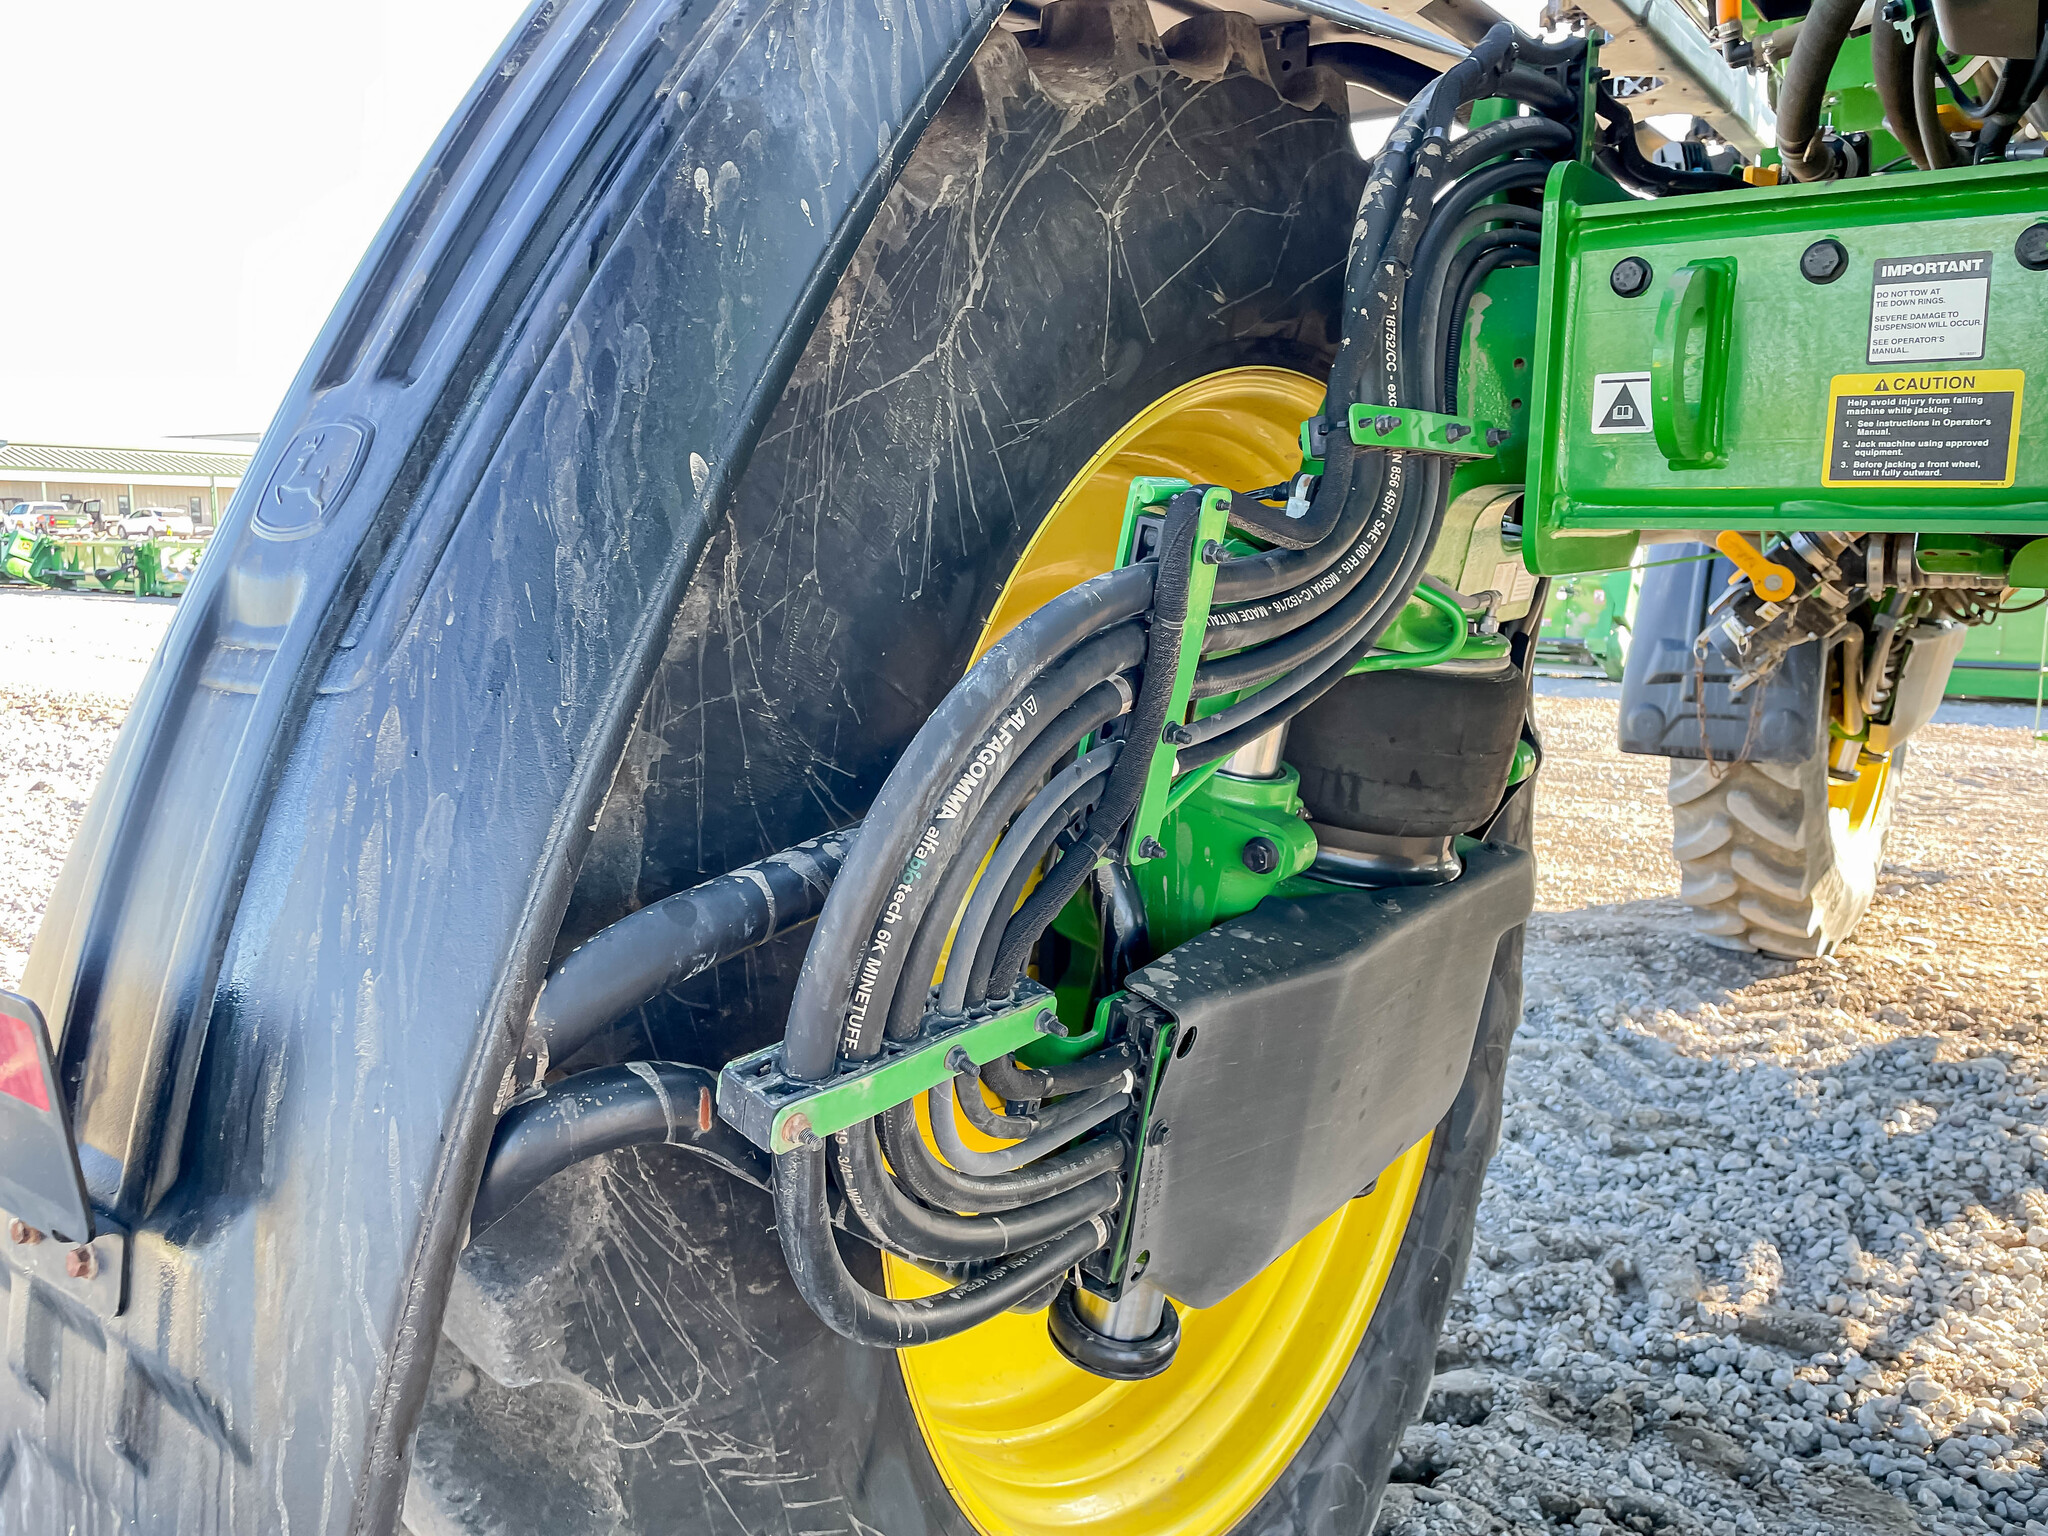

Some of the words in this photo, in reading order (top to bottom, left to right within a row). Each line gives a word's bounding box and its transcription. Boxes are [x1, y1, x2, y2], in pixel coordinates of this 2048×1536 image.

[1881, 259, 1984, 278] IMPORTANT
[1876, 291, 1889, 299] DO
[1890, 290, 1908, 298] NOT
[1910, 289, 1928, 297] TOW
[1890, 299, 1916, 307] DOWN
[1917, 297, 1946, 305] RINGS.
[1875, 314, 1908, 322] SEVERE
[1910, 312, 1946, 321] DAMAGE
[1874, 322, 1926, 332] SUSPENSION
[1950, 319, 1983, 327] OCCUR.
[1386, 315, 1396, 372] 18752/CC
[1891, 336, 1945, 345] OPERATOR'S
[1872, 347, 1909, 355] MANUAL.
[1893, 376, 1976, 391] CAUTION
[1847, 399, 1868, 407] Help
[1871, 398, 1896, 406] avoid
[1898, 398, 1925, 406] injury
[1953, 397, 1983, 405] falling
[1914, 406, 1952, 415] jacking:
[1876, 419, 1929, 427] instructions
[1943, 418, 1991, 427] Operator's
[1855, 440, 1876, 448] Jack
[1918, 440, 1943, 448] using
[1945, 439, 1989, 448] approved
[1855, 448, 1903, 457] equipment.
[1884, 460, 1917, 469] jacking
[1927, 460, 1949, 468] front
[1951, 460, 1981, 469] wheel,
[1388, 466, 1401, 488] 856
[1881, 469, 1901, 478] fully
[1903, 469, 1942, 477] outward.
[1381, 489, 1397, 514] 4SH
[1367, 519, 1386, 543] SAE
[1355, 541, 1372, 559] 100
[1341, 555, 1360, 574] R15
[1311, 572, 1340, 595] MSHA
[1272, 588, 1315, 613] IC-152/16
[1226, 612, 1240, 623] IN
[1238, 606, 1269, 621] MADE
[936, 707, 1026, 819] ALFAGOMMA
[884, 825, 940, 924] alfabiotech
[871, 928, 892, 955] 6K
[844, 956, 883, 1050] MINETUFF
